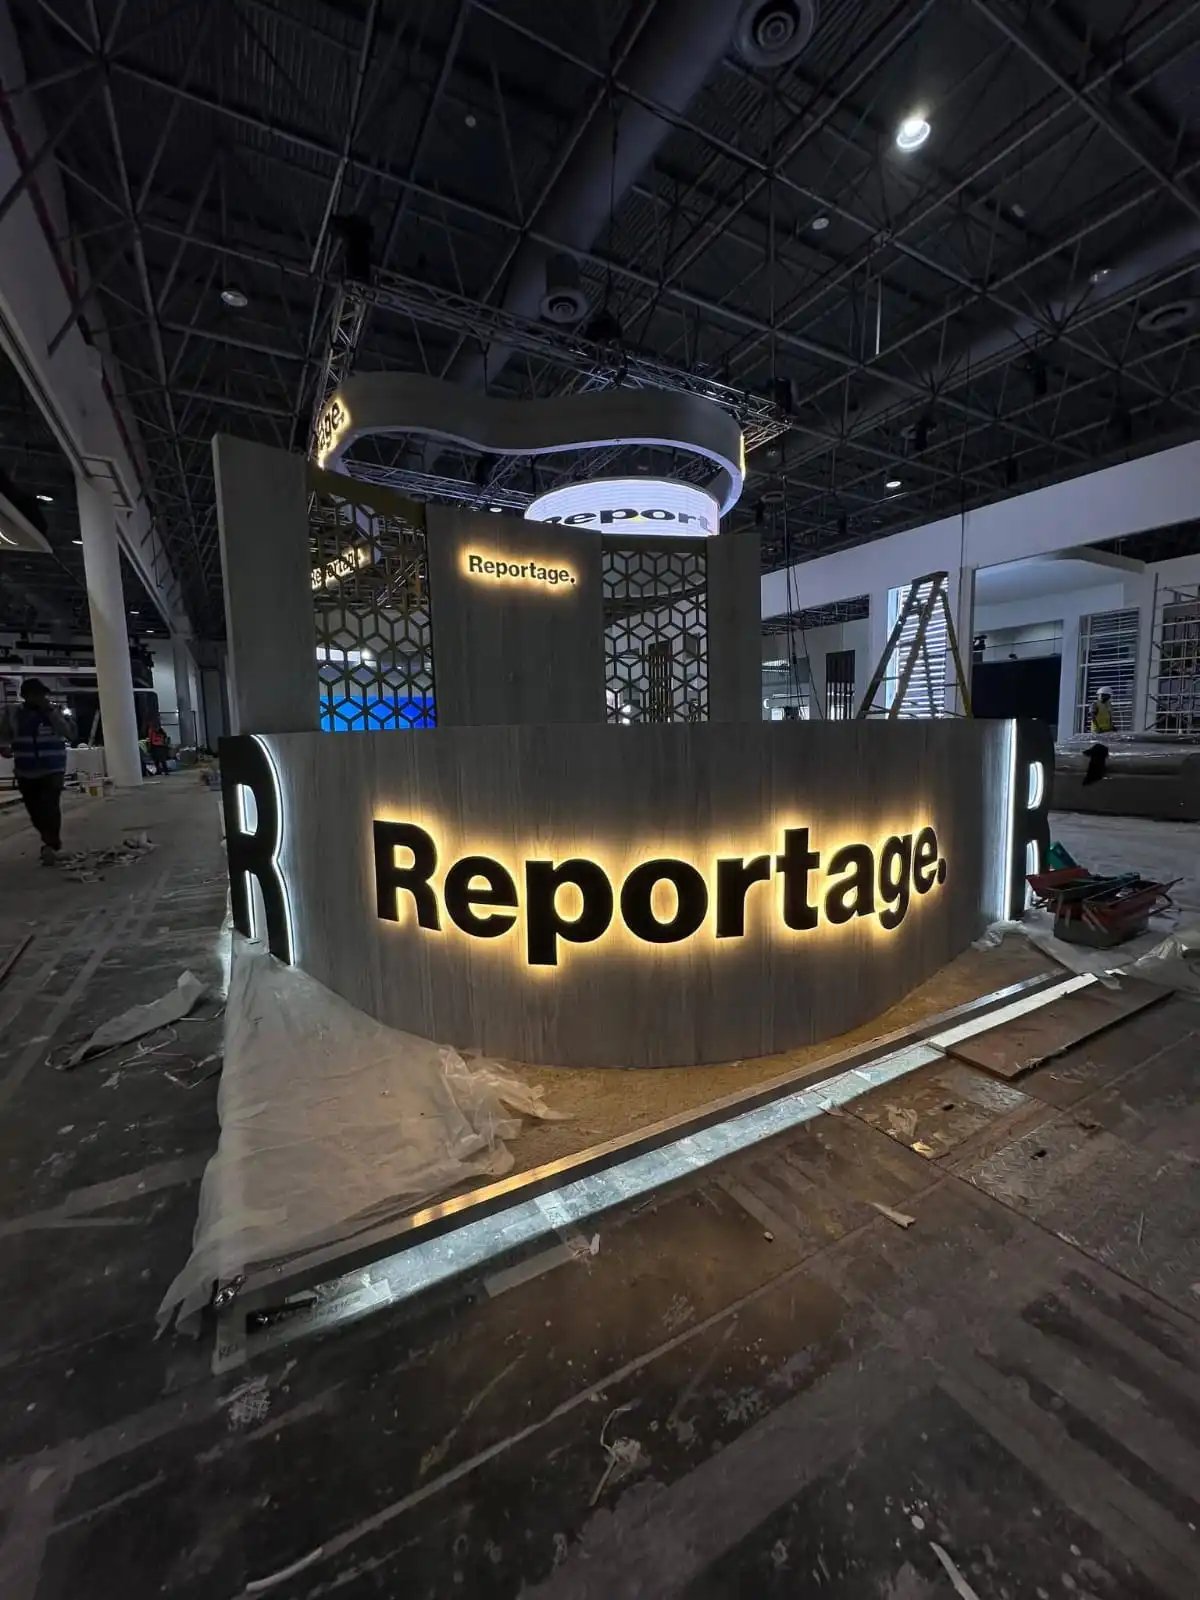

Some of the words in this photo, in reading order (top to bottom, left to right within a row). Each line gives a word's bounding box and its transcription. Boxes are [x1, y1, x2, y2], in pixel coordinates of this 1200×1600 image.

[468, 555, 575, 585] Reportage.
[218, 735, 295, 966] R
[372, 818, 946, 966] Reportage.
